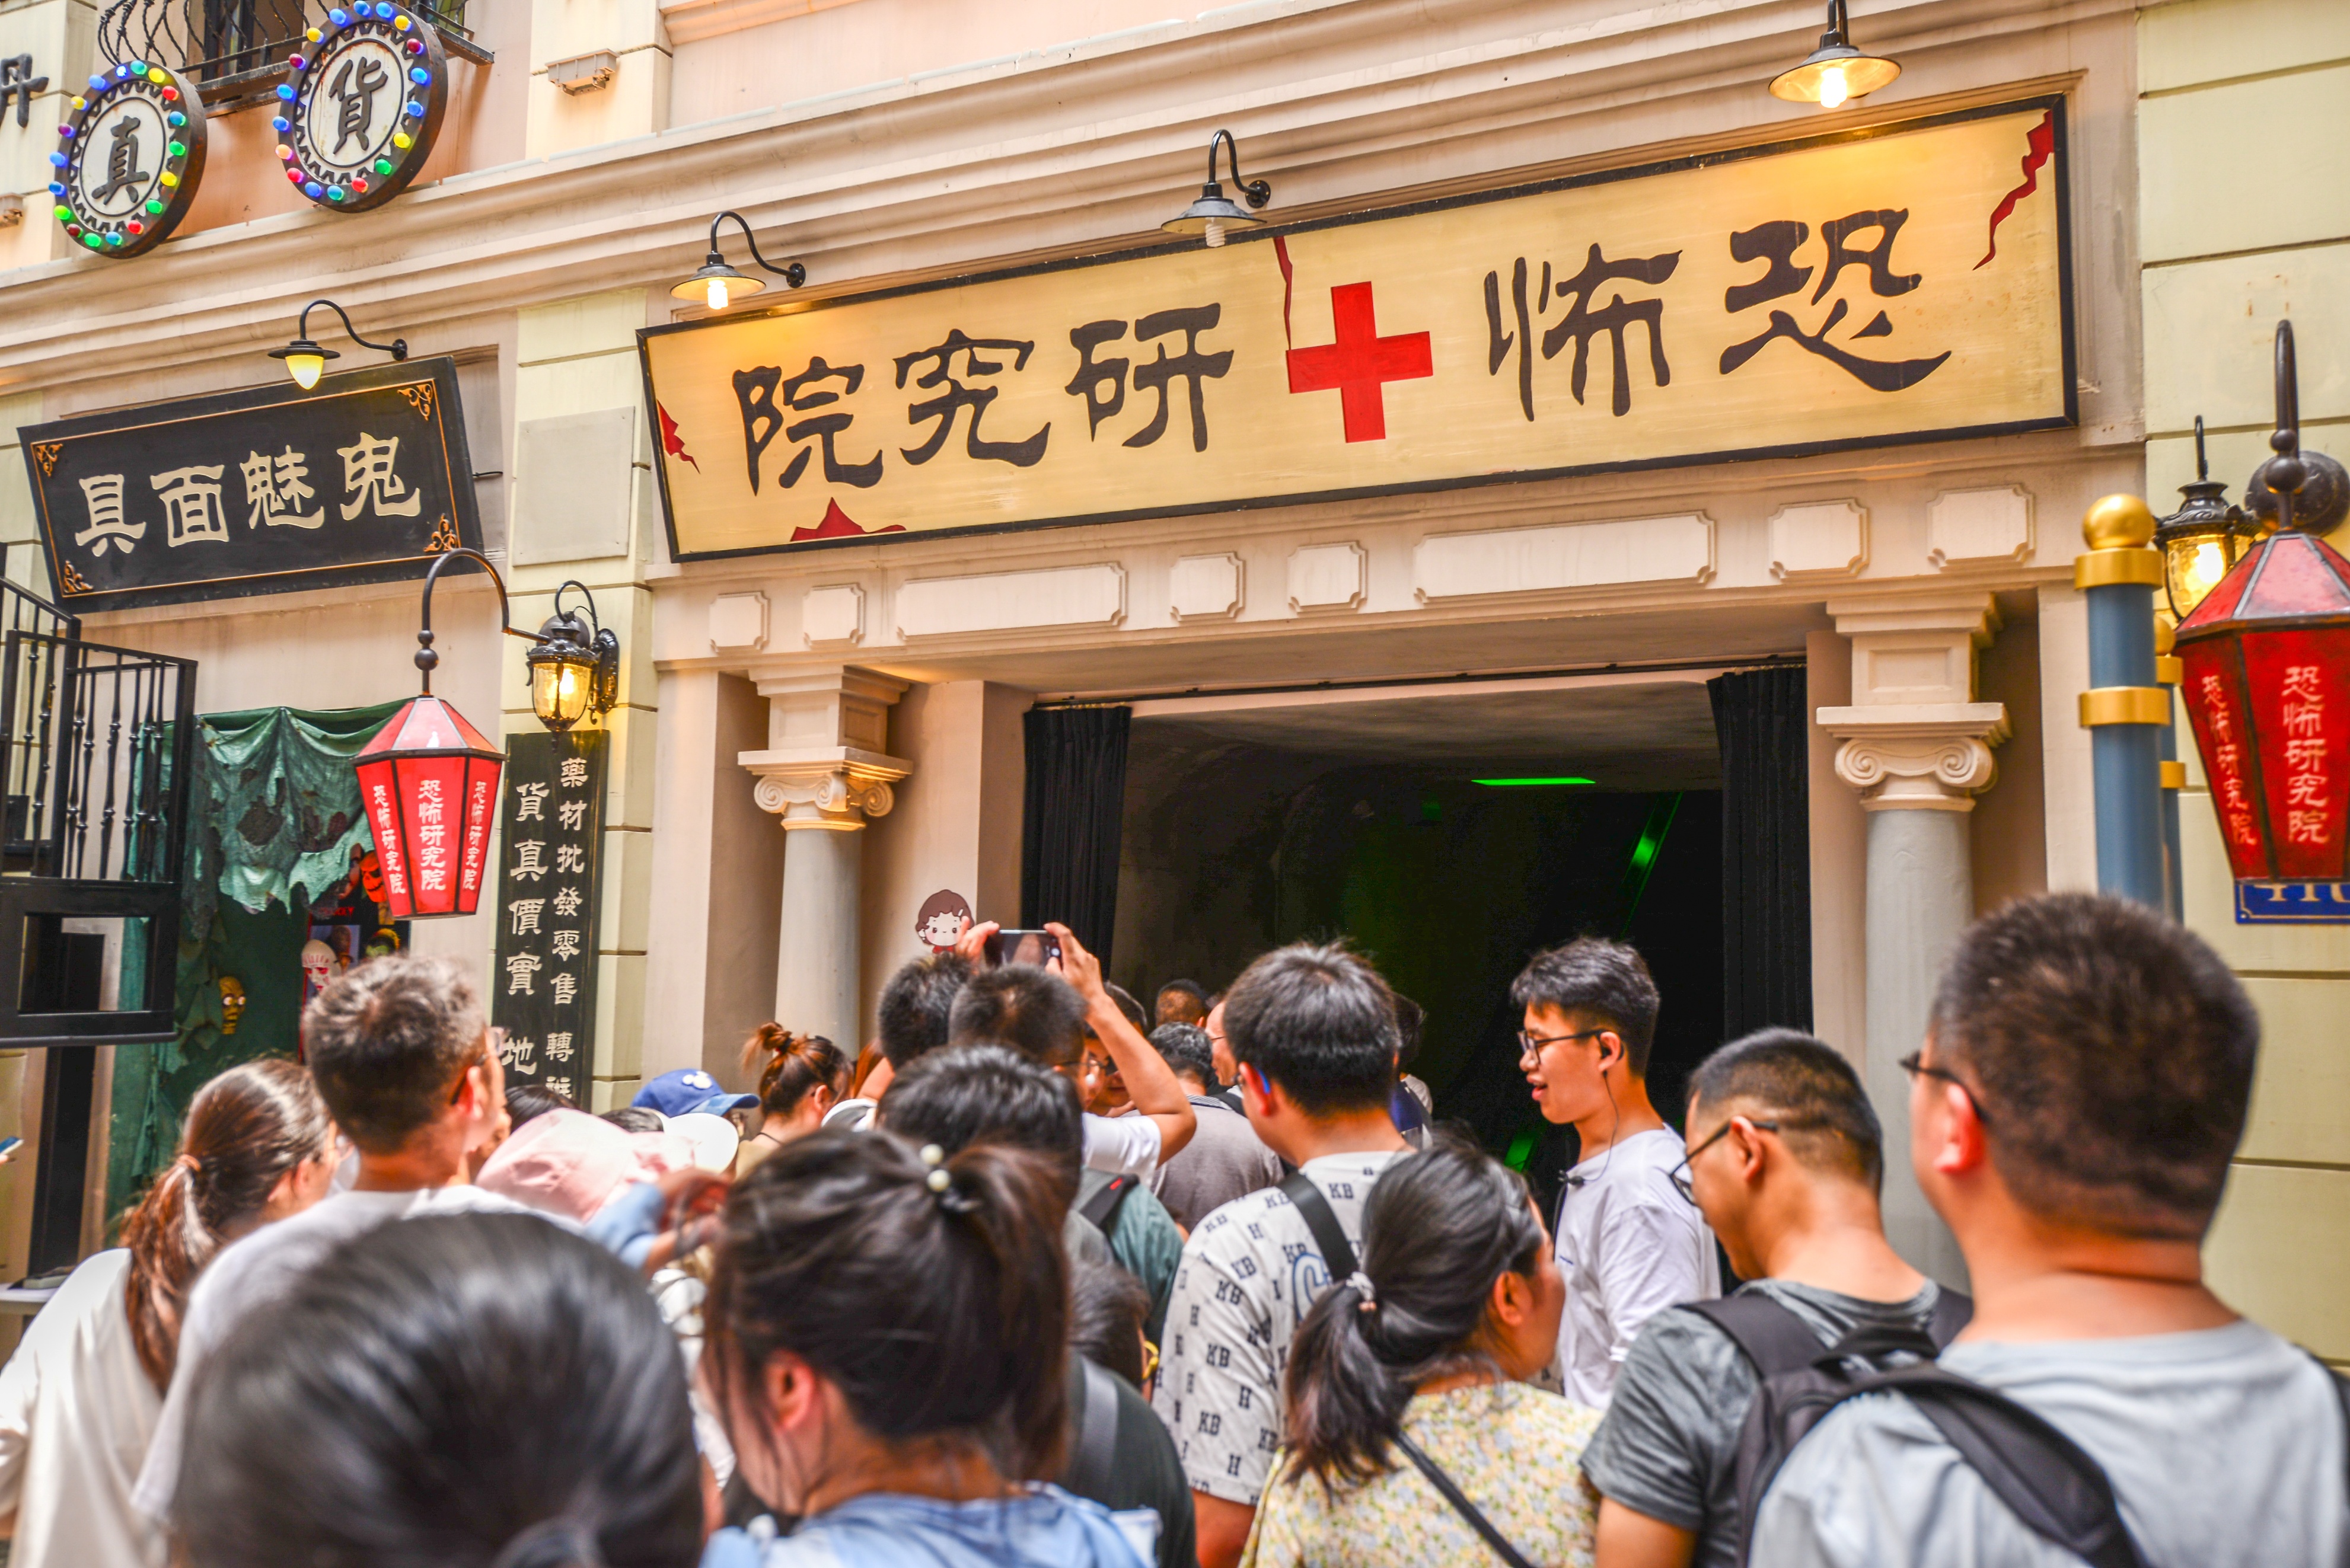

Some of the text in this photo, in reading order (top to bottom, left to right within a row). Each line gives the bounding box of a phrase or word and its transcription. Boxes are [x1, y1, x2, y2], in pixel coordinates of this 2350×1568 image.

[92, 115, 149, 205] 真
[329, 56, 388, 155] 貨
[2282, 666, 2330, 844] 恐怖研究院
[373, 785, 406, 895] 恐怖研究院
[418, 780, 446, 891] 恐怖研究院
[463, 781, 487, 891] 恐怖研究院
[1329, 1183, 1354, 1200] KB
